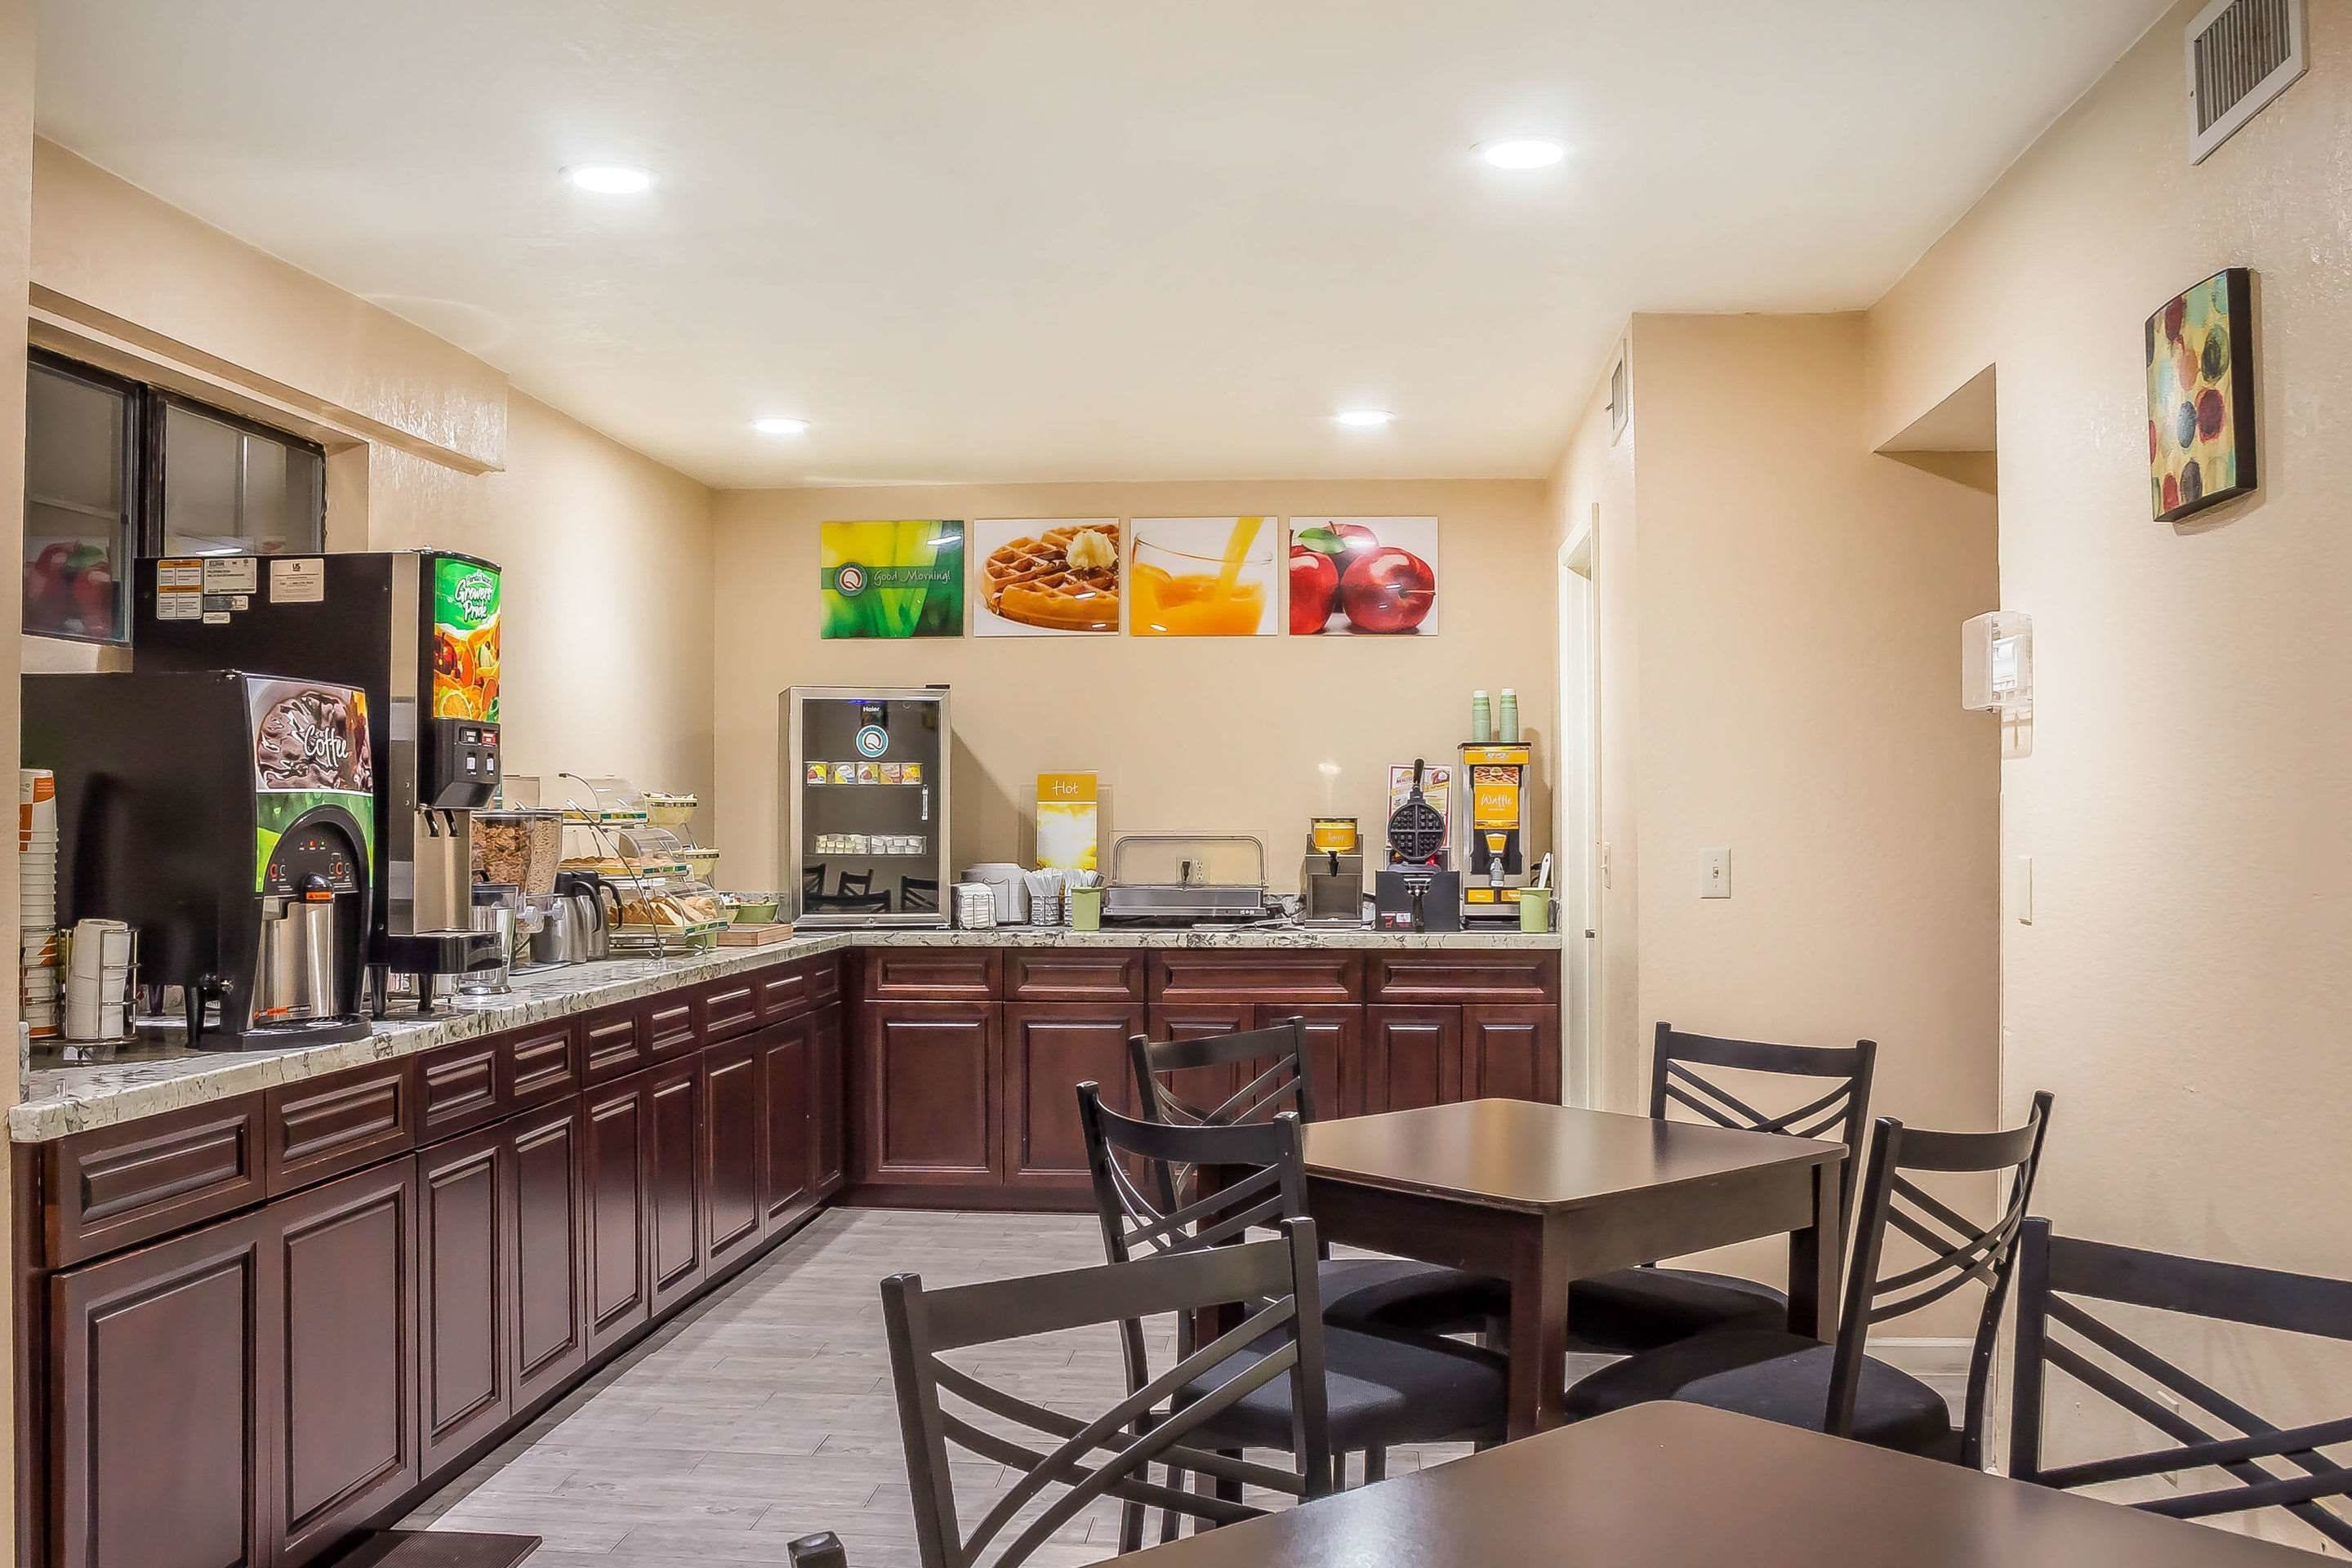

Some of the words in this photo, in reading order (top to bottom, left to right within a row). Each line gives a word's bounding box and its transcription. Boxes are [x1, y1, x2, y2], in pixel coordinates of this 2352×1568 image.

[874, 569, 897, 586] Good
[900, 569, 951, 585] Morning!
[462, 600, 488, 622] Pride
[304, 724, 349, 768] Coffee
[1051, 779, 1079, 796] Hot
[1481, 792, 1512, 809] Waffle
